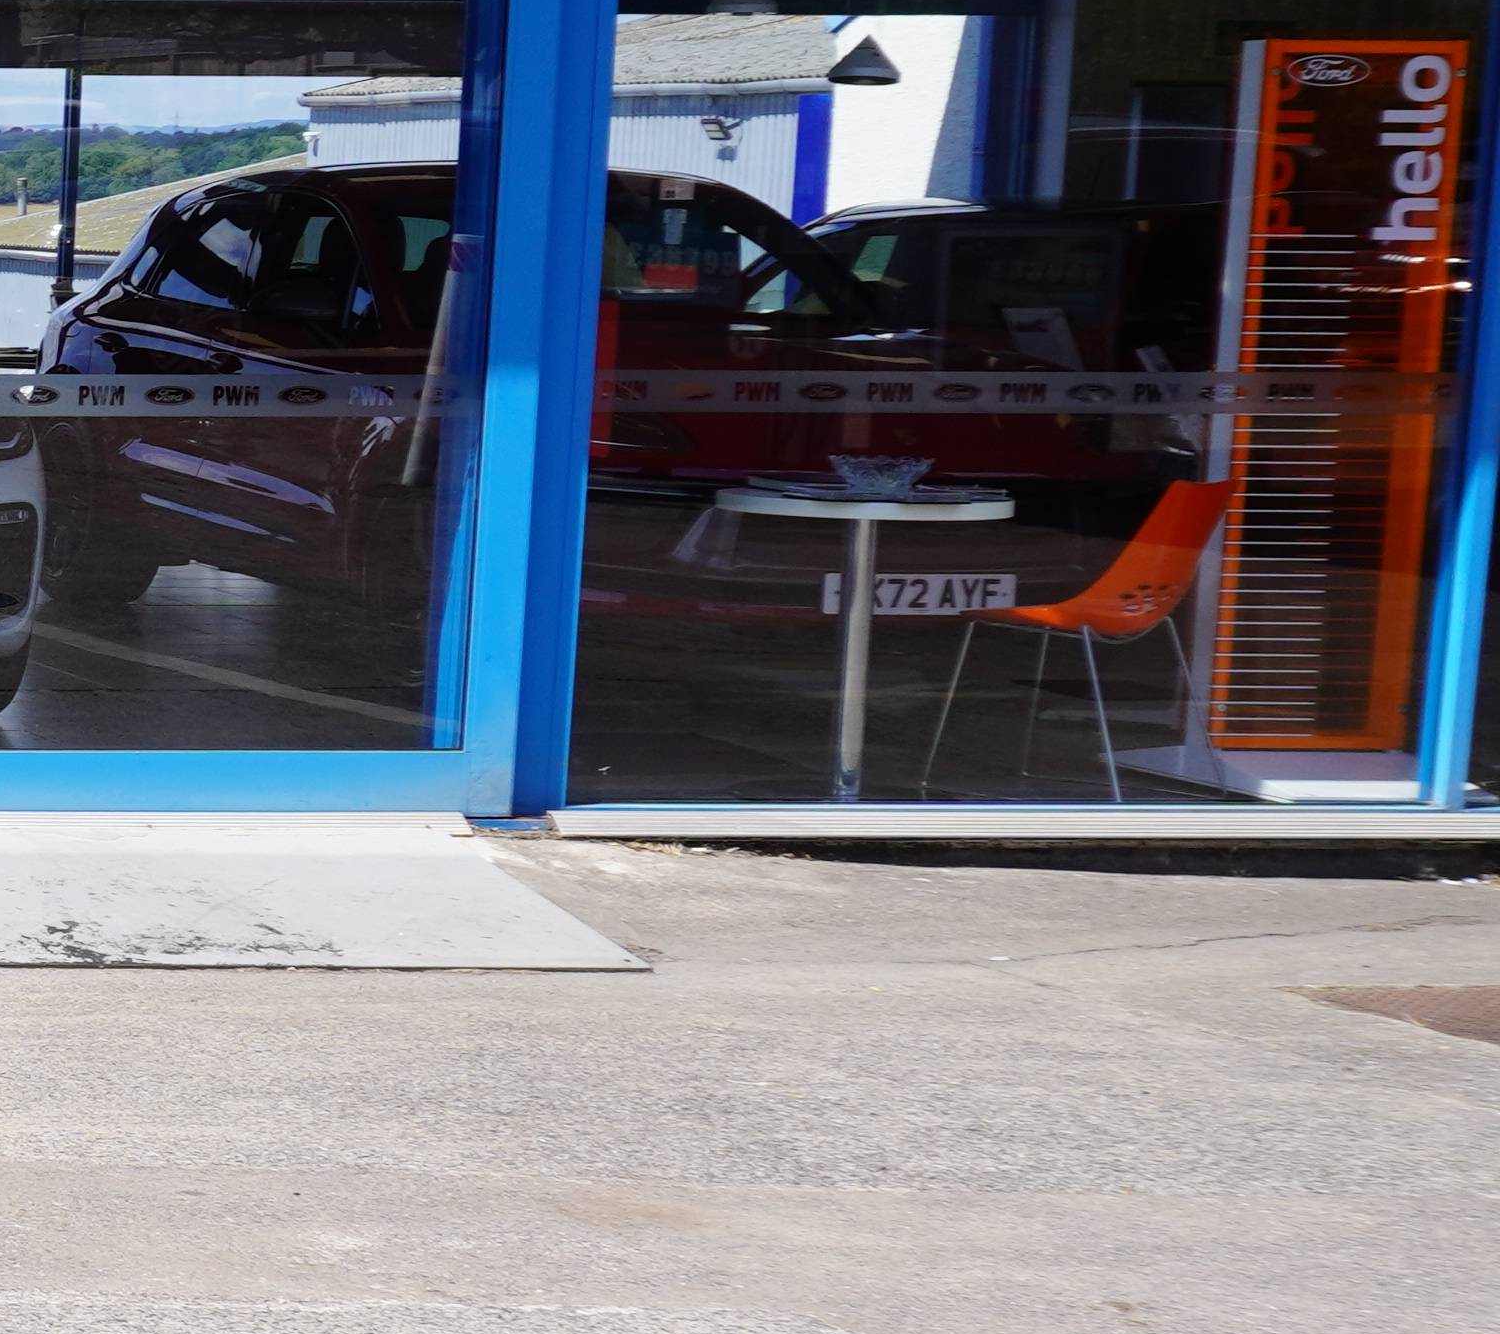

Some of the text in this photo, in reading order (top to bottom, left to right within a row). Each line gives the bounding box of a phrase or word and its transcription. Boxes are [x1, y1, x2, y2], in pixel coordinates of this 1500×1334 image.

[1297, 56, 1361, 83] Ford
[1371, 55, 1451, 241] hello
[77, 385, 126, 406] PWM
[151, 386, 188, 402] Ford
[212, 385, 260, 406] PWM
[283, 387, 321, 403] Ford
[348, 385, 394, 406] PWM
[734, 381, 781, 402] PWM
[866, 382, 914, 402] PWM
[1000, 382, 1047, 403] PWM
[871, 578, 1002, 608] X72 AYF
